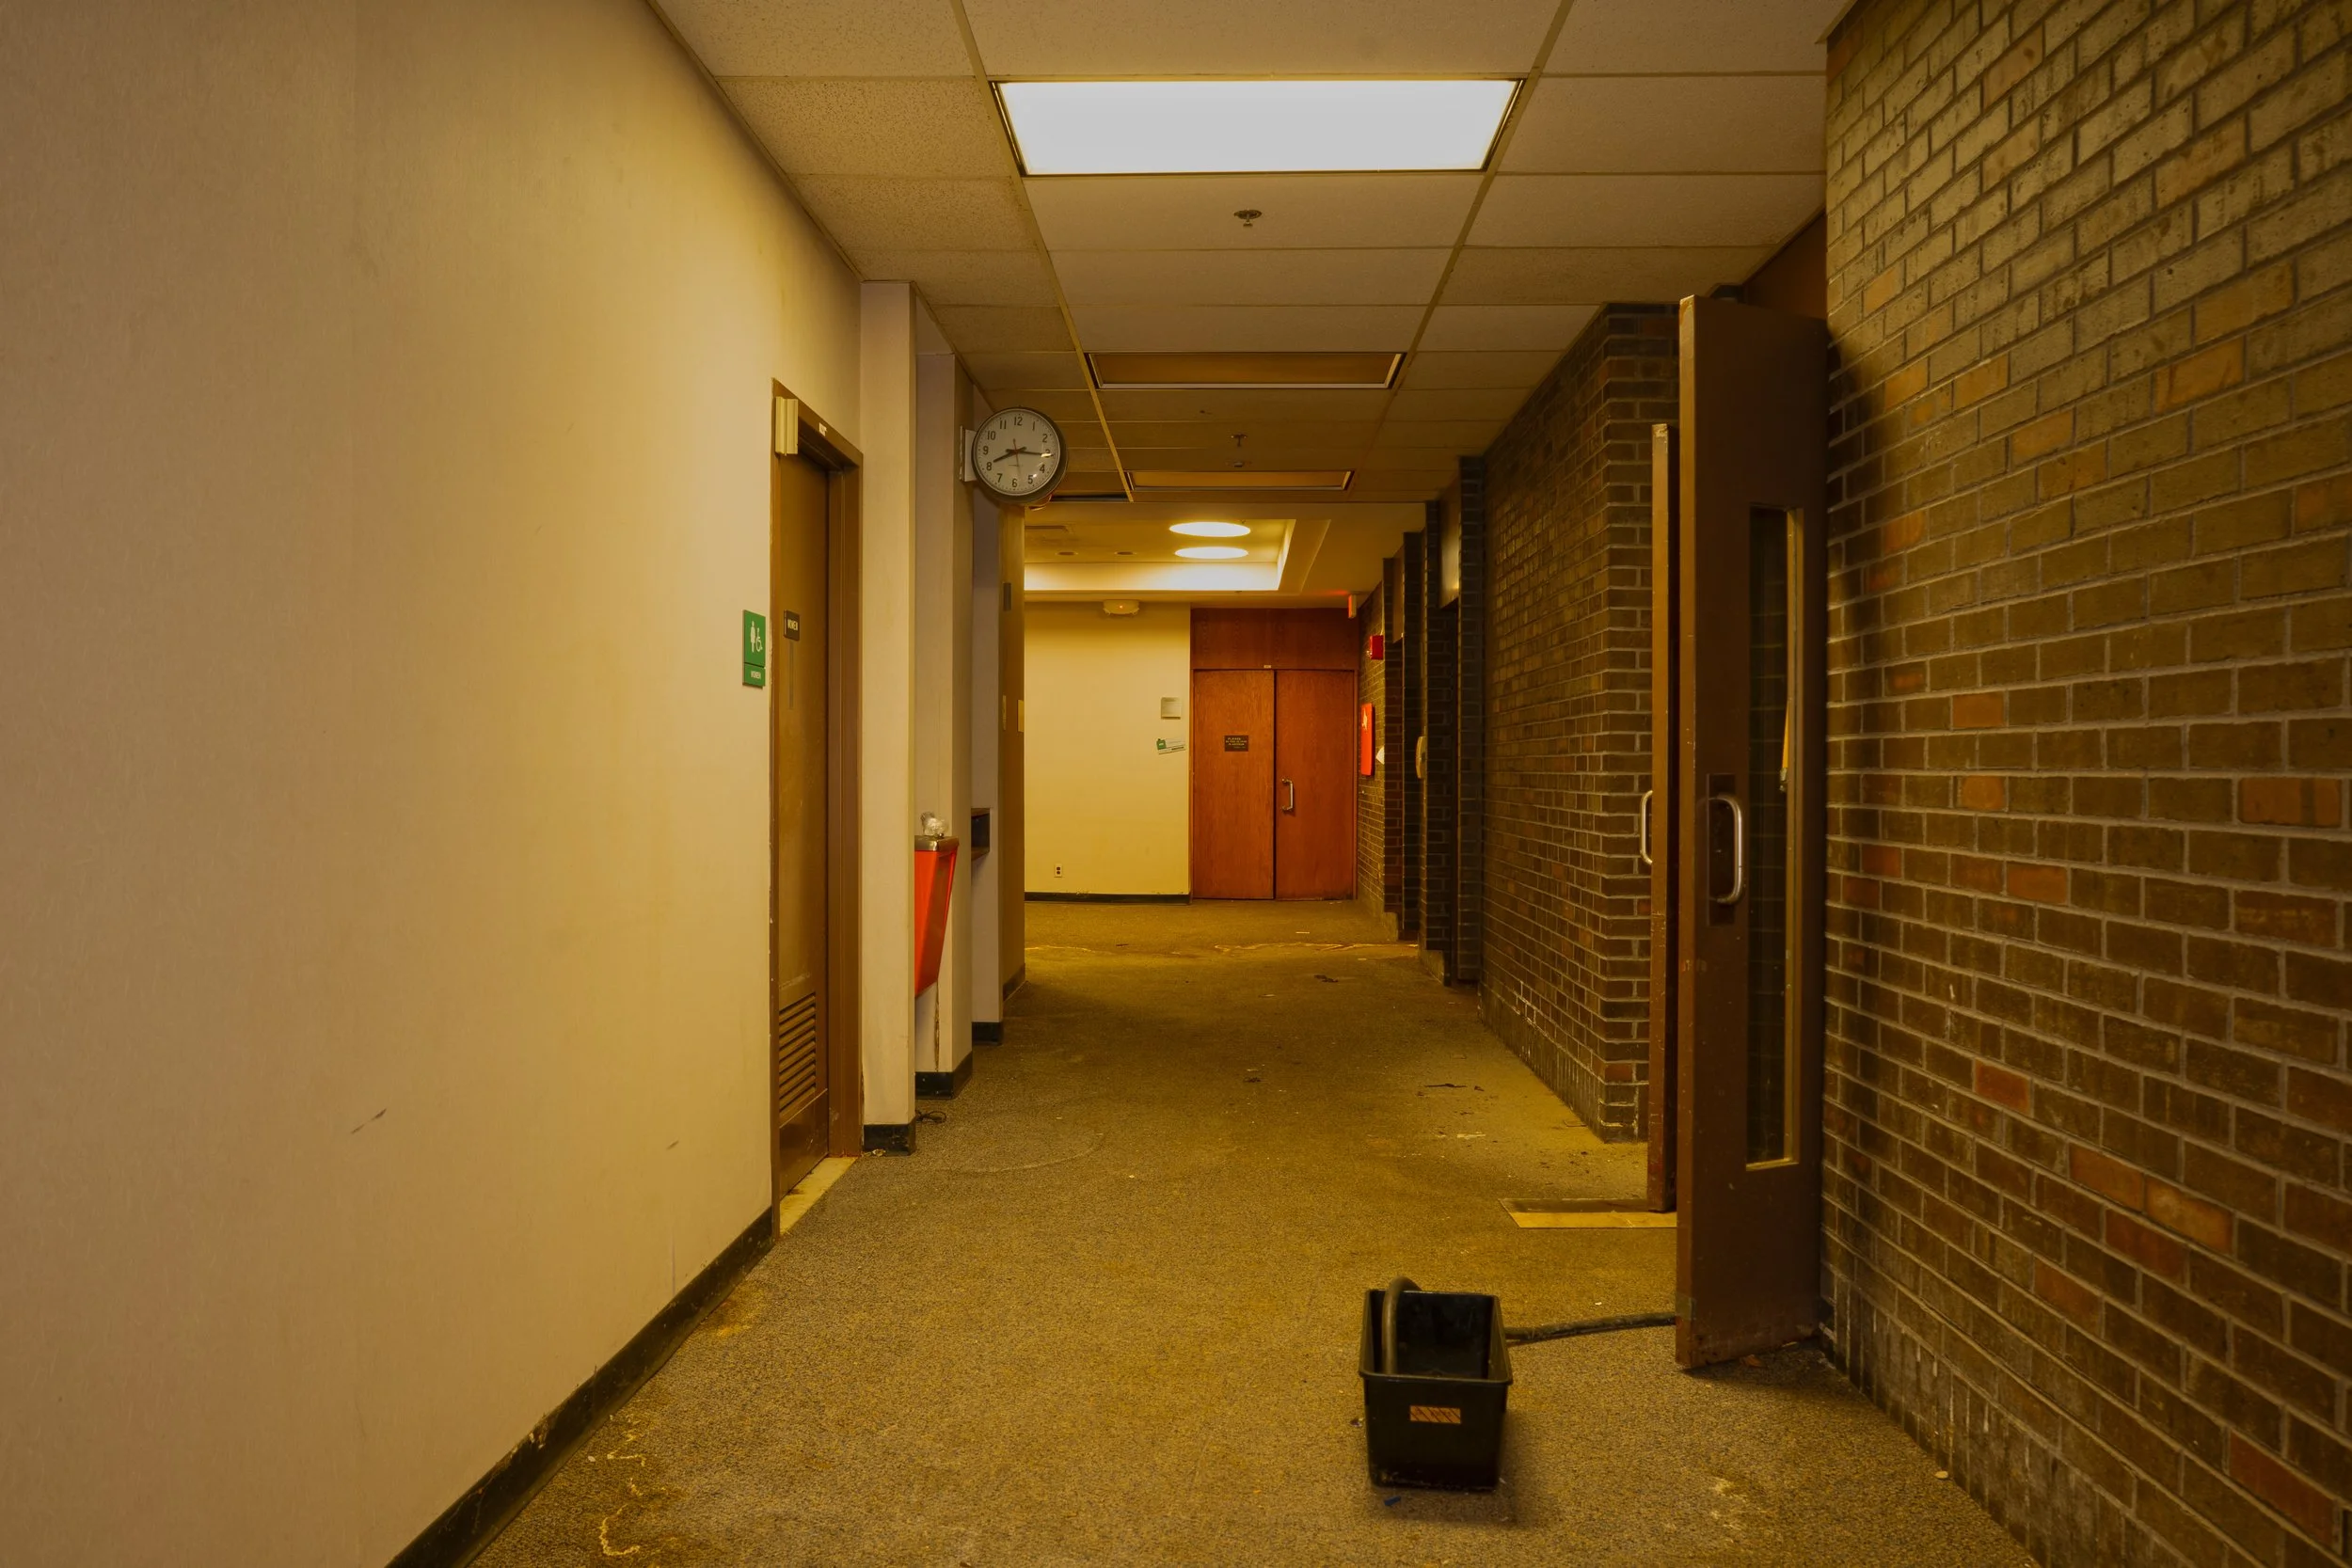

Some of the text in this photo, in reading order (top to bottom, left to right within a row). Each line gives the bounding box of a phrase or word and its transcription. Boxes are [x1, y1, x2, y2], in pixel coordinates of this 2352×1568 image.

[999, 420, 1007, 430] 11
[1013, 417, 1023, 426] 12
[1032, 421, 1036, 431] 1
[987, 431, 995, 440] 10
[1042, 434, 1048, 443] 2
[983, 446, 989, 455] 9
[987, 462, 993, 471] 8
[1040, 465, 1045, 473] 4
[997, 473, 1003, 483] 7
[1028, 475, 1034, 484] 5
[1011, 479, 1017, 487] 6
[787, 619, 798, 631] WOMEN
